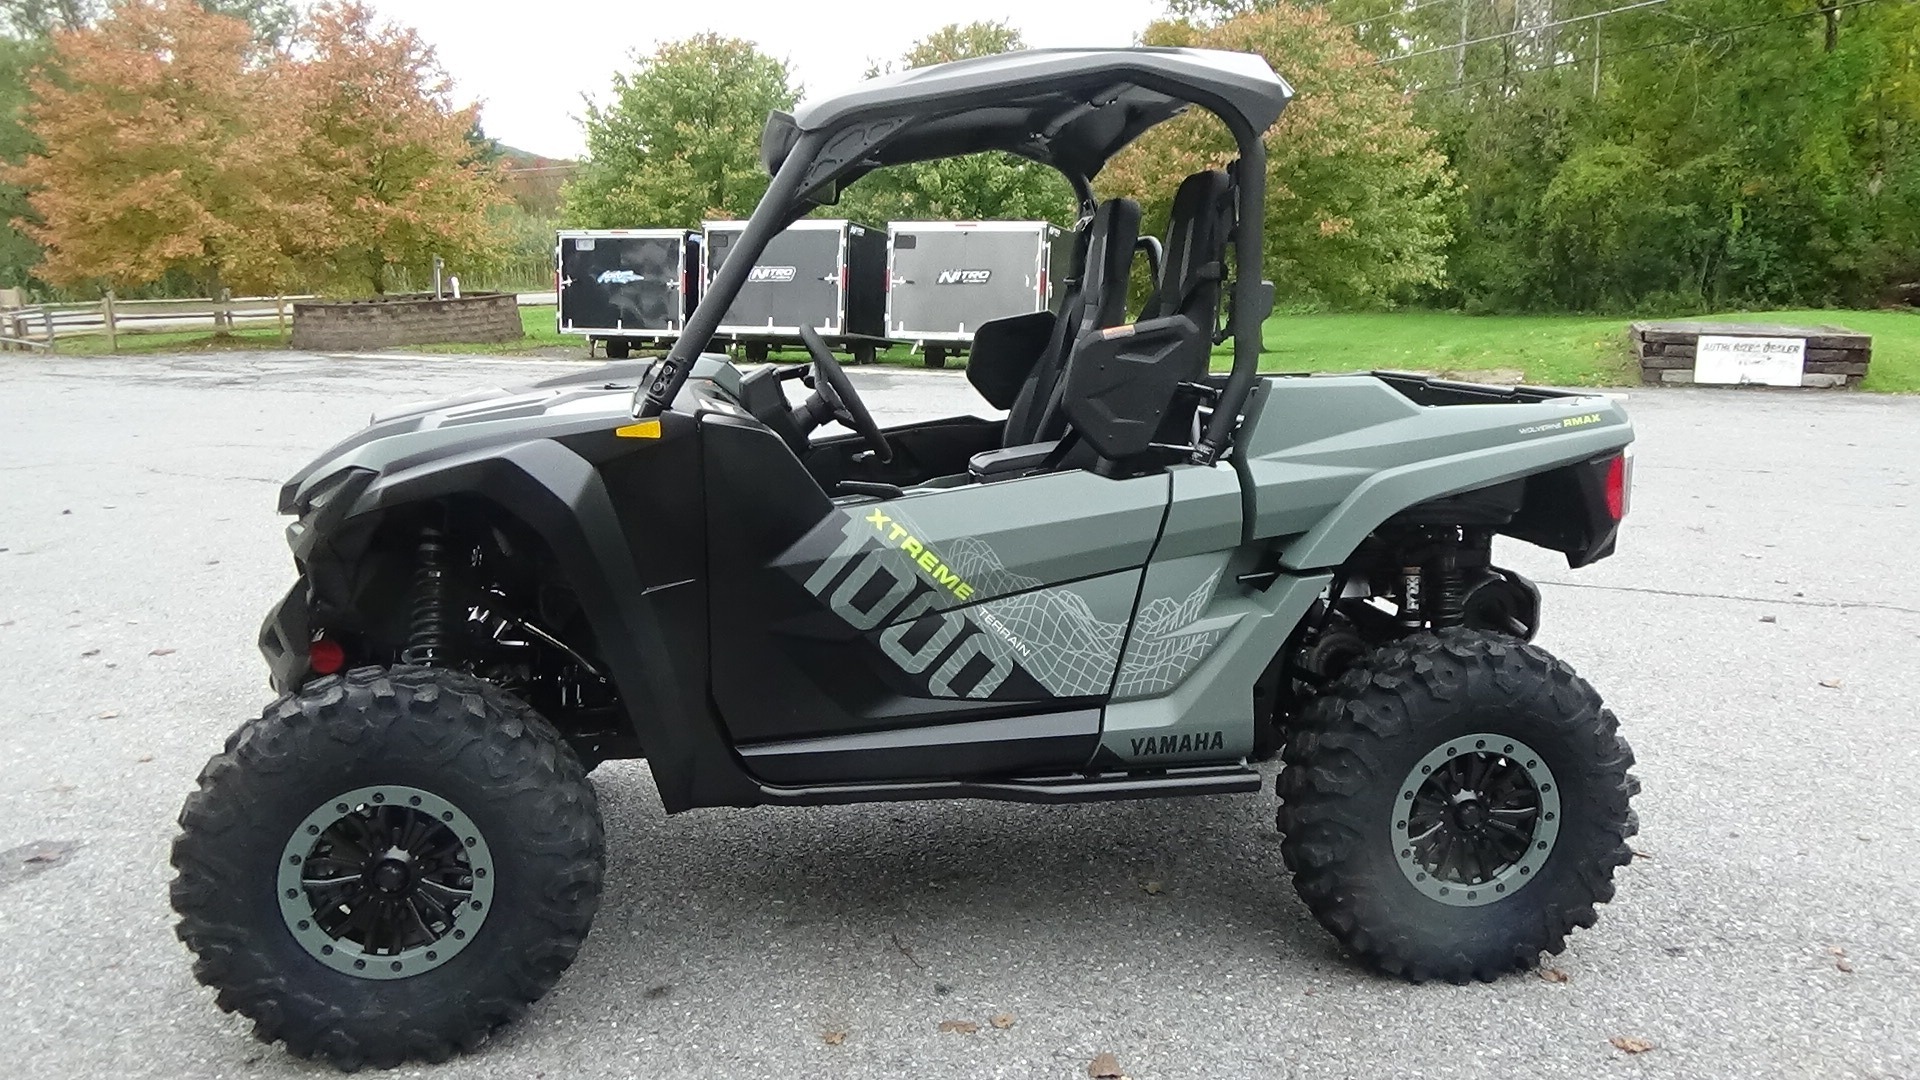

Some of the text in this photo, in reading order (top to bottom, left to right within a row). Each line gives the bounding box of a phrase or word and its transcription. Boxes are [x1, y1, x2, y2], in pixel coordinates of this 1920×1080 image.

[938, 269, 991, 284] NITRO
[1563, 413, 1602, 428] RMAX
[865, 507, 976, 602] XTREME
[803, 507, 1014, 699] 1000
[978, 606, 1031, 658] TERRAIN
[1130, 731, 1224, 756] YAMAHA
